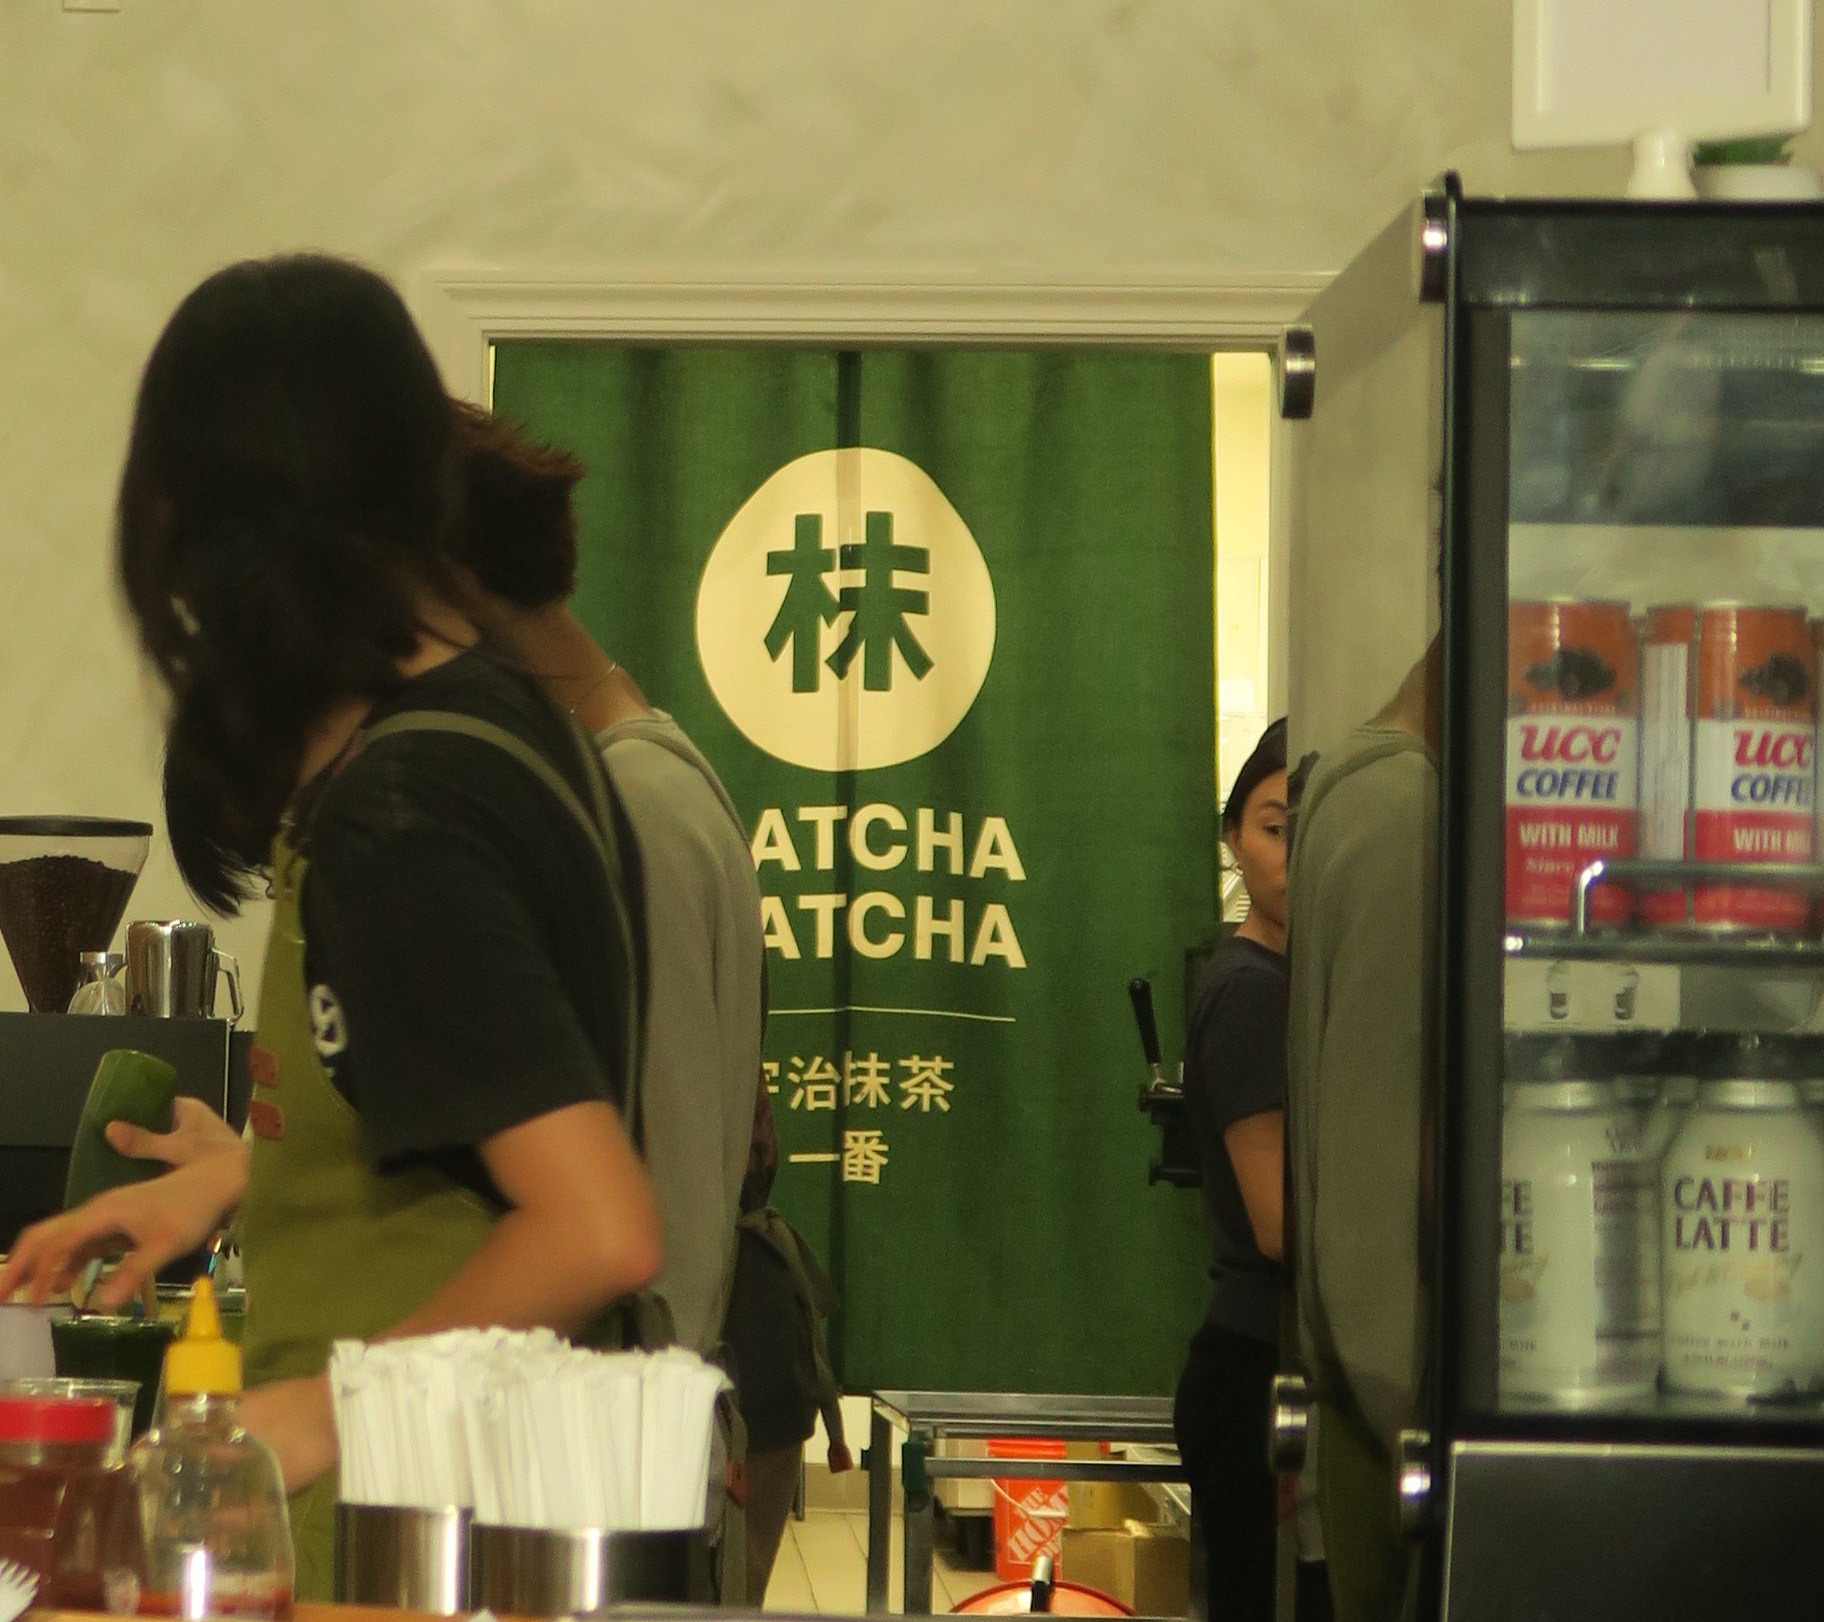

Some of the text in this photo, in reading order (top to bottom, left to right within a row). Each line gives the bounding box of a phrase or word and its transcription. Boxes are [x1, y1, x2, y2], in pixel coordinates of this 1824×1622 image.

[1516, 767, 1619, 800] COFFEE
[750, 802, 1027, 881] ATCHA
[1520, 822, 1620, 850] WITH MILK
[761, 891, 1028, 970] ATCHA
[788, 1129, 890, 1185] 一番
[1674, 1216, 1791, 1252] LATTE
